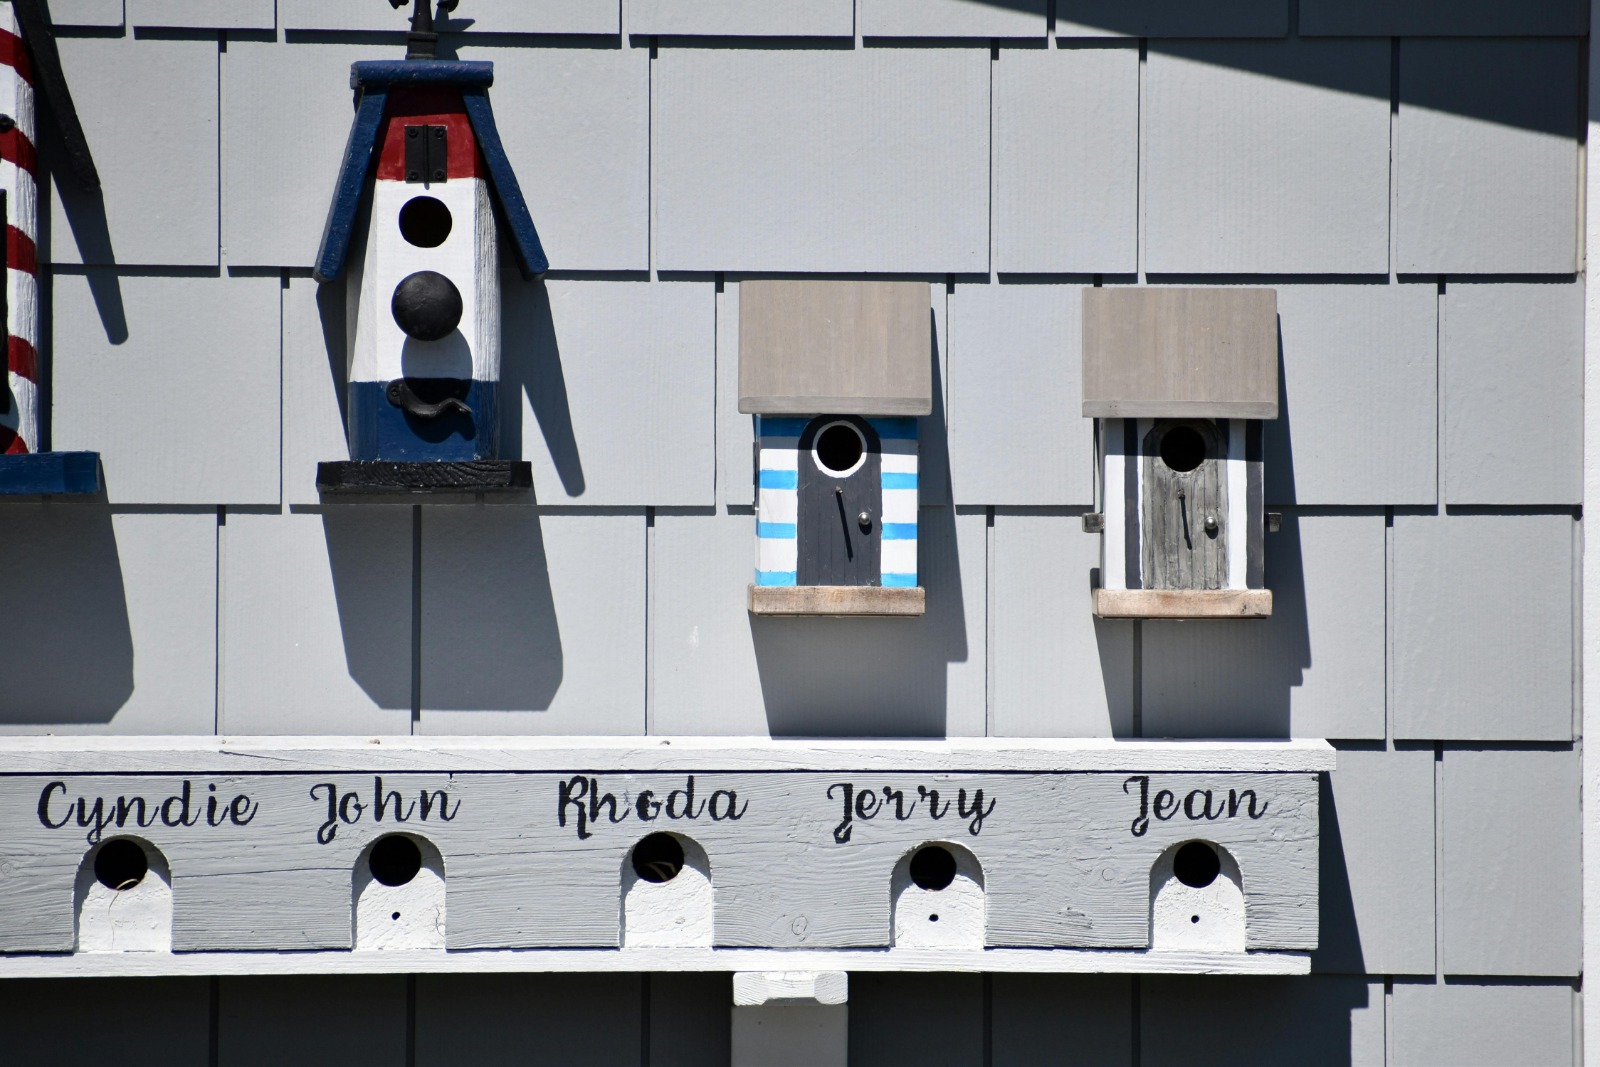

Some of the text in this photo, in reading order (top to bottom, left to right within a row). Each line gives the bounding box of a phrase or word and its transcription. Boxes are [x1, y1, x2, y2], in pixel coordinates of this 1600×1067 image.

[37, 780, 259, 844] Cyndie
[310, 777, 461, 844] John
[557, 775, 749, 839] Rhoda
[827, 782, 997, 844] Jerry
[1124, 775, 1269, 837] Jean
